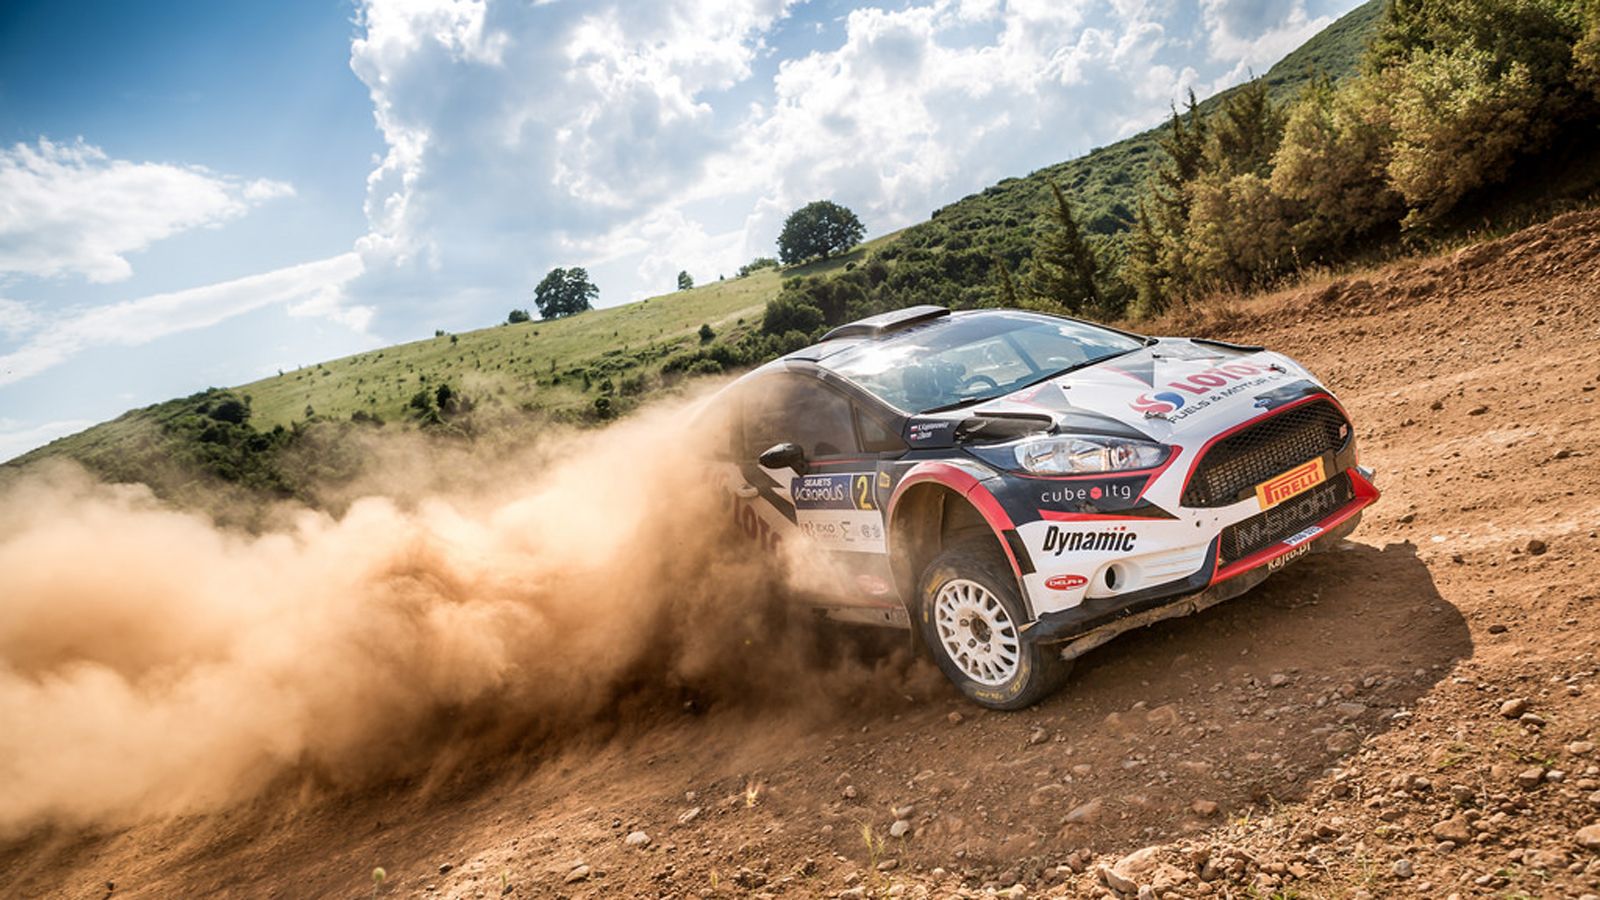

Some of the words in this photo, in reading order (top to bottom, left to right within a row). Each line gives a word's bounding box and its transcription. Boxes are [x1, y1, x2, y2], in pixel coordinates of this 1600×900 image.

[1167, 399, 1211, 424] FUELS
[856, 475, 873, 510] 2
[1041, 487, 1087, 503] cube
[1263, 461, 1321, 506] PIRELLI
[1042, 525, 1138, 556] Dynamic
